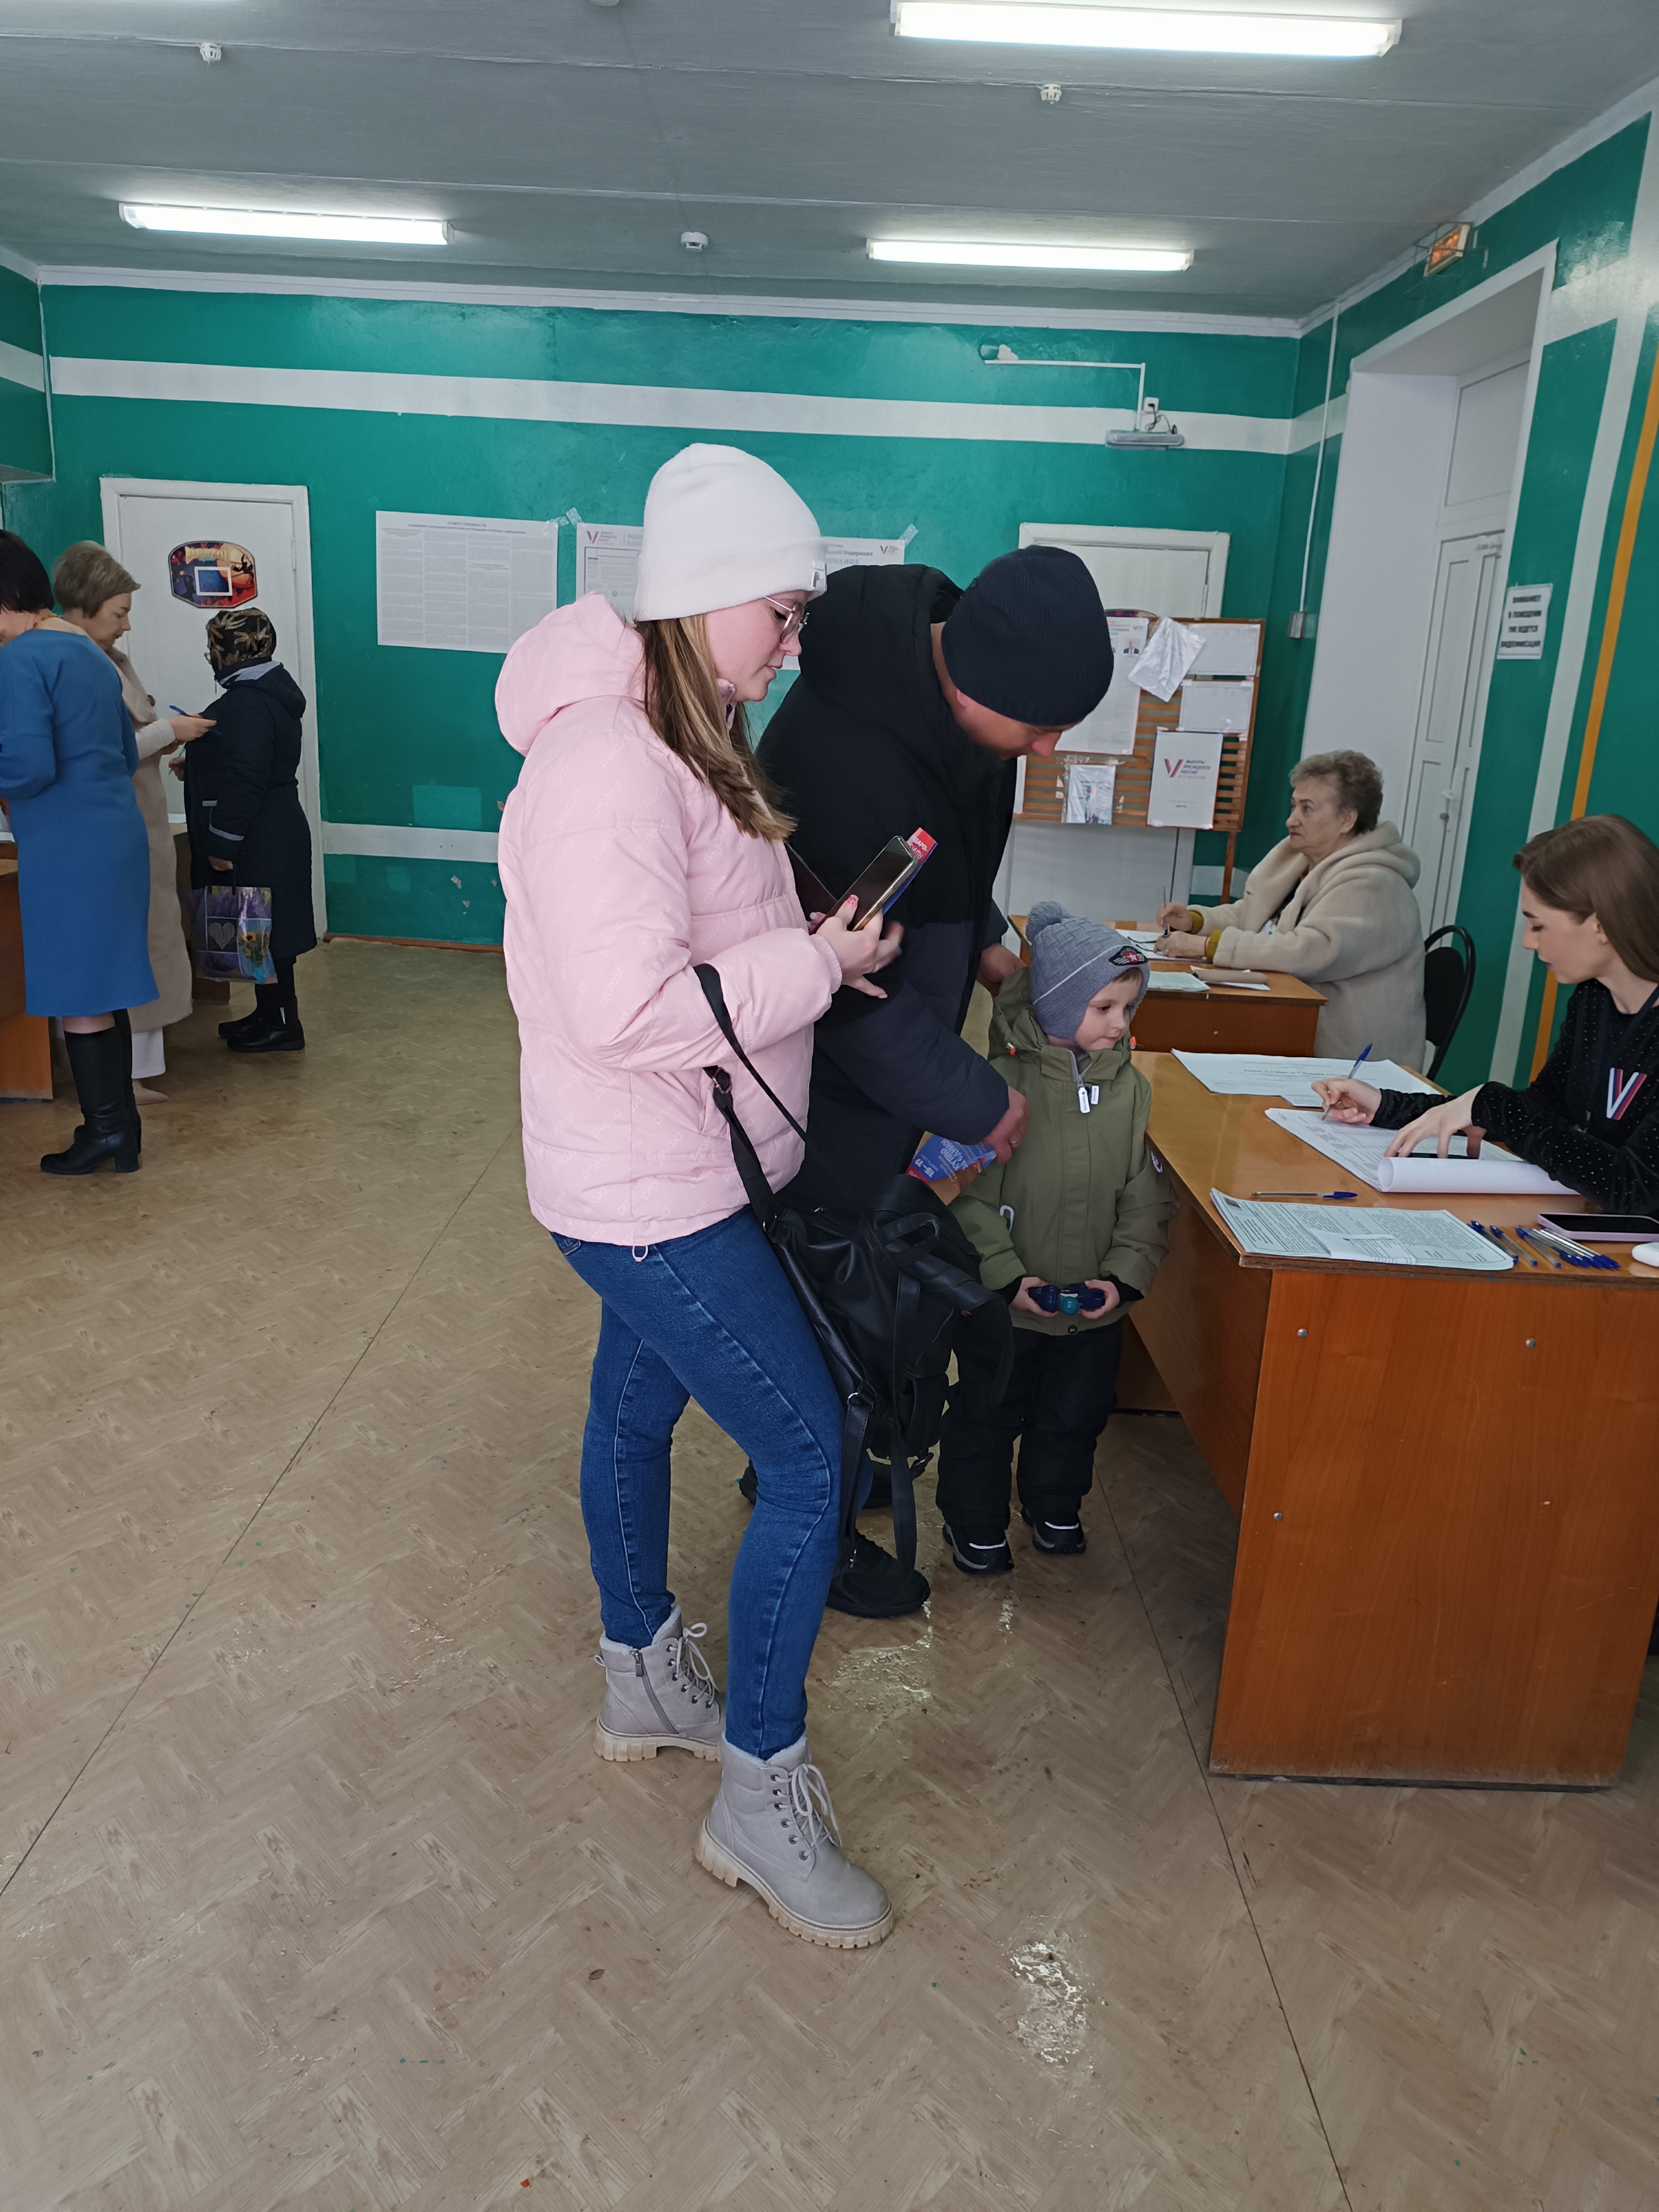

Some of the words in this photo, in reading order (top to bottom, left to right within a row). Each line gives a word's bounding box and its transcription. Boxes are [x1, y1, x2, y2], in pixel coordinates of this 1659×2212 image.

[599, 735, 630, 768] protest
[592, 780, 624, 819] protest
[704, 827, 725, 864] protest
[599, 966, 624, 1009] protest
[591, 1107, 622, 1139] protest
[654, 1093, 682, 1126] protest
